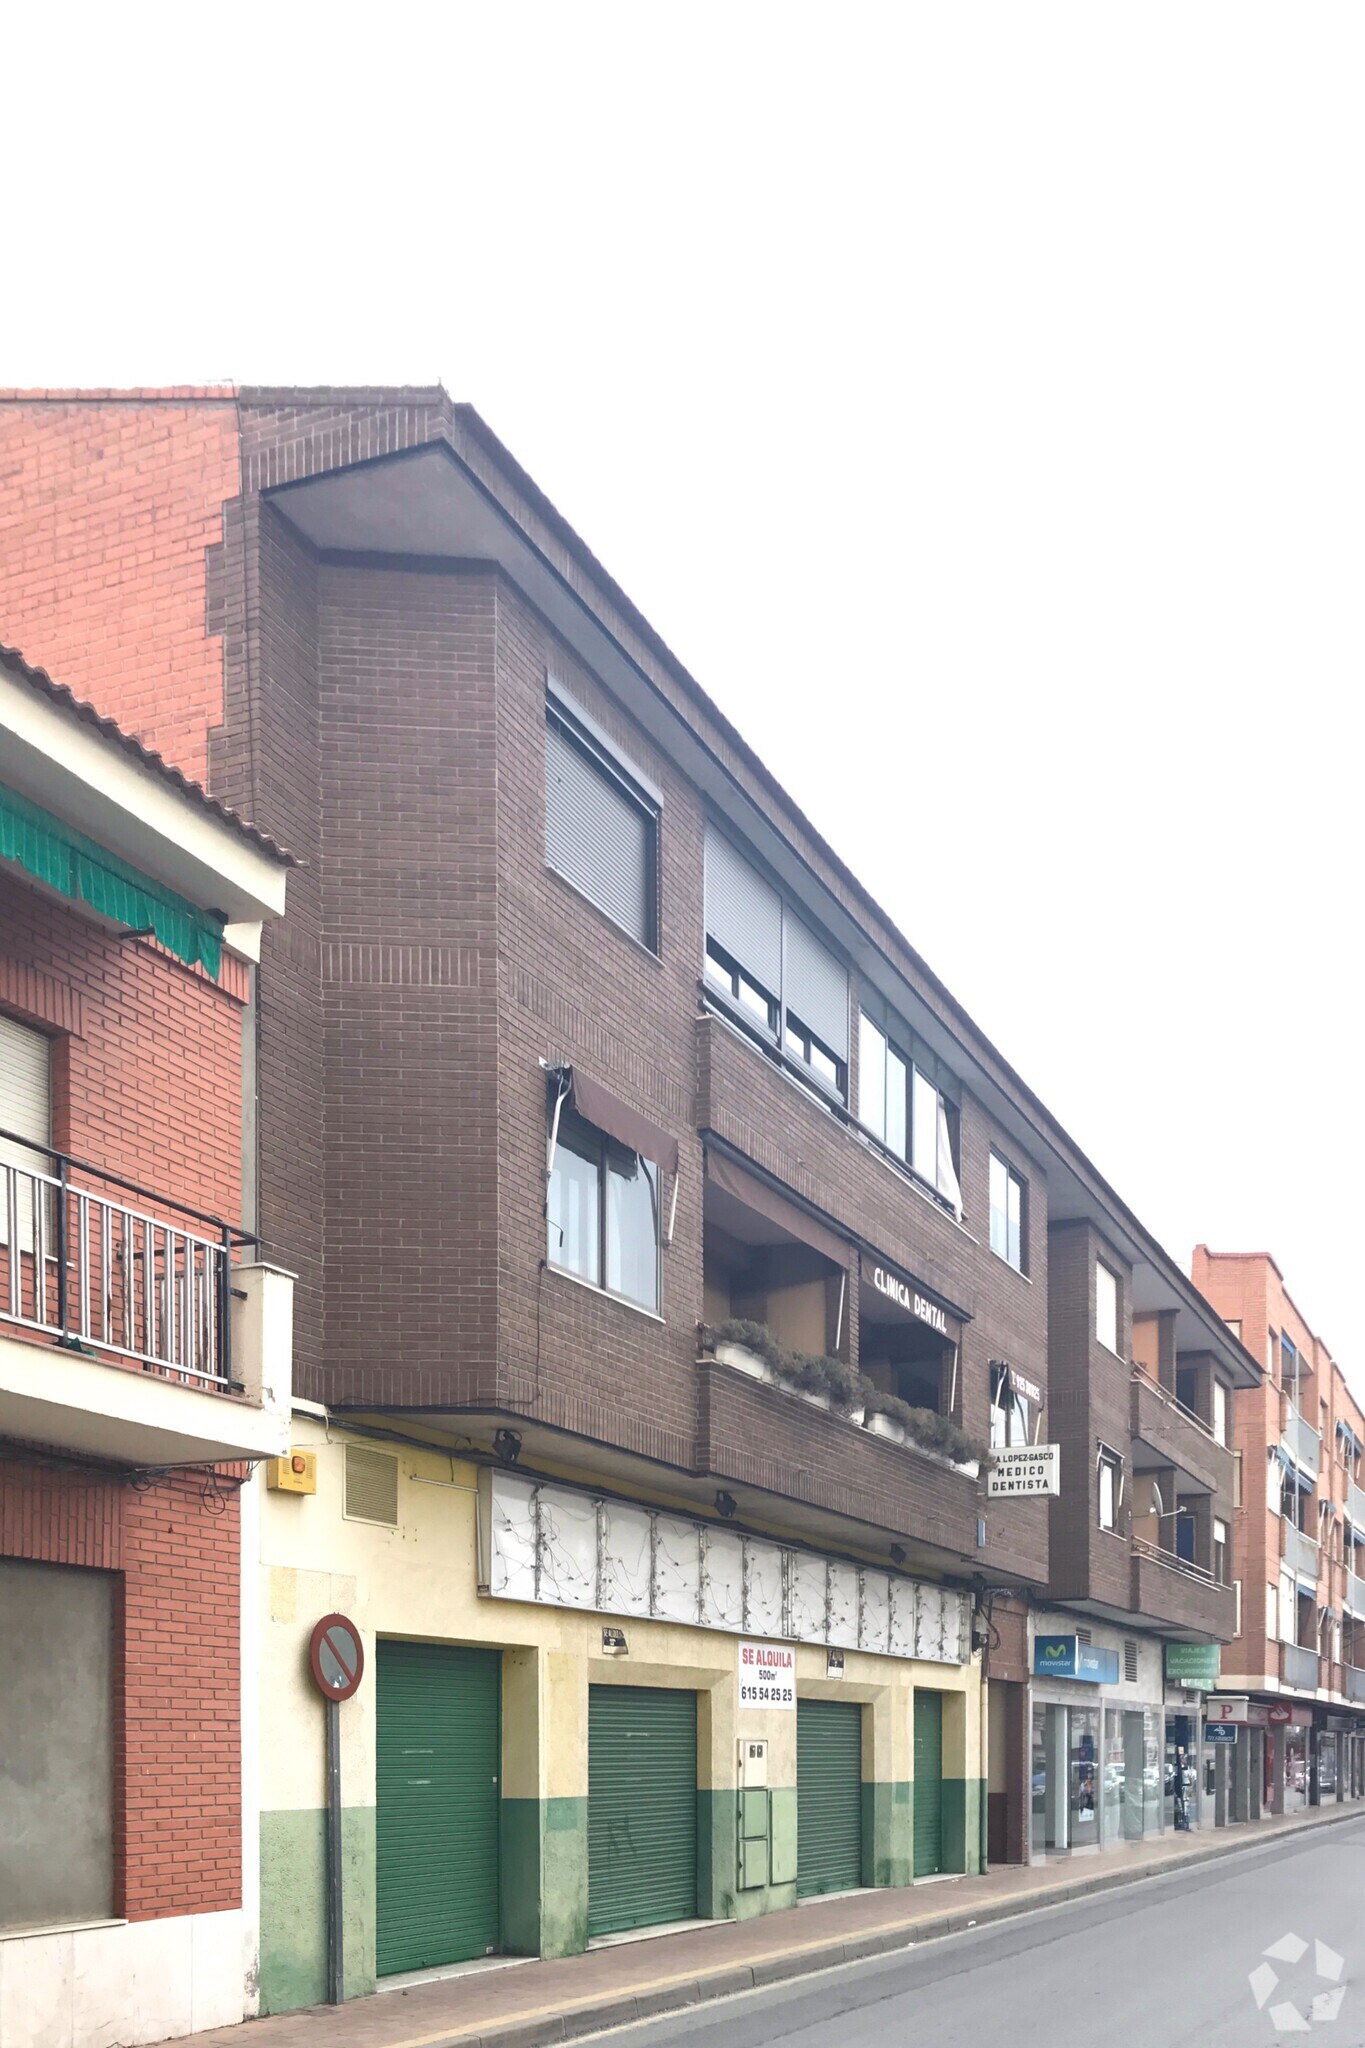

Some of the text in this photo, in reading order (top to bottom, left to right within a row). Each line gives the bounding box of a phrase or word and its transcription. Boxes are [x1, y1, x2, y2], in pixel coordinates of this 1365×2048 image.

[874, 1267, 947, 1333] CLINICA DENTAL
[998, 1465, 1044, 1477] MEDICO
[992, 1479, 1049, 1491] DENTISTA
[742, 1648, 792, 1668] SE ALQUILA
[742, 1686, 792, 1701] 615 54 25 25
[1220, 1705, 1233, 1719] P
